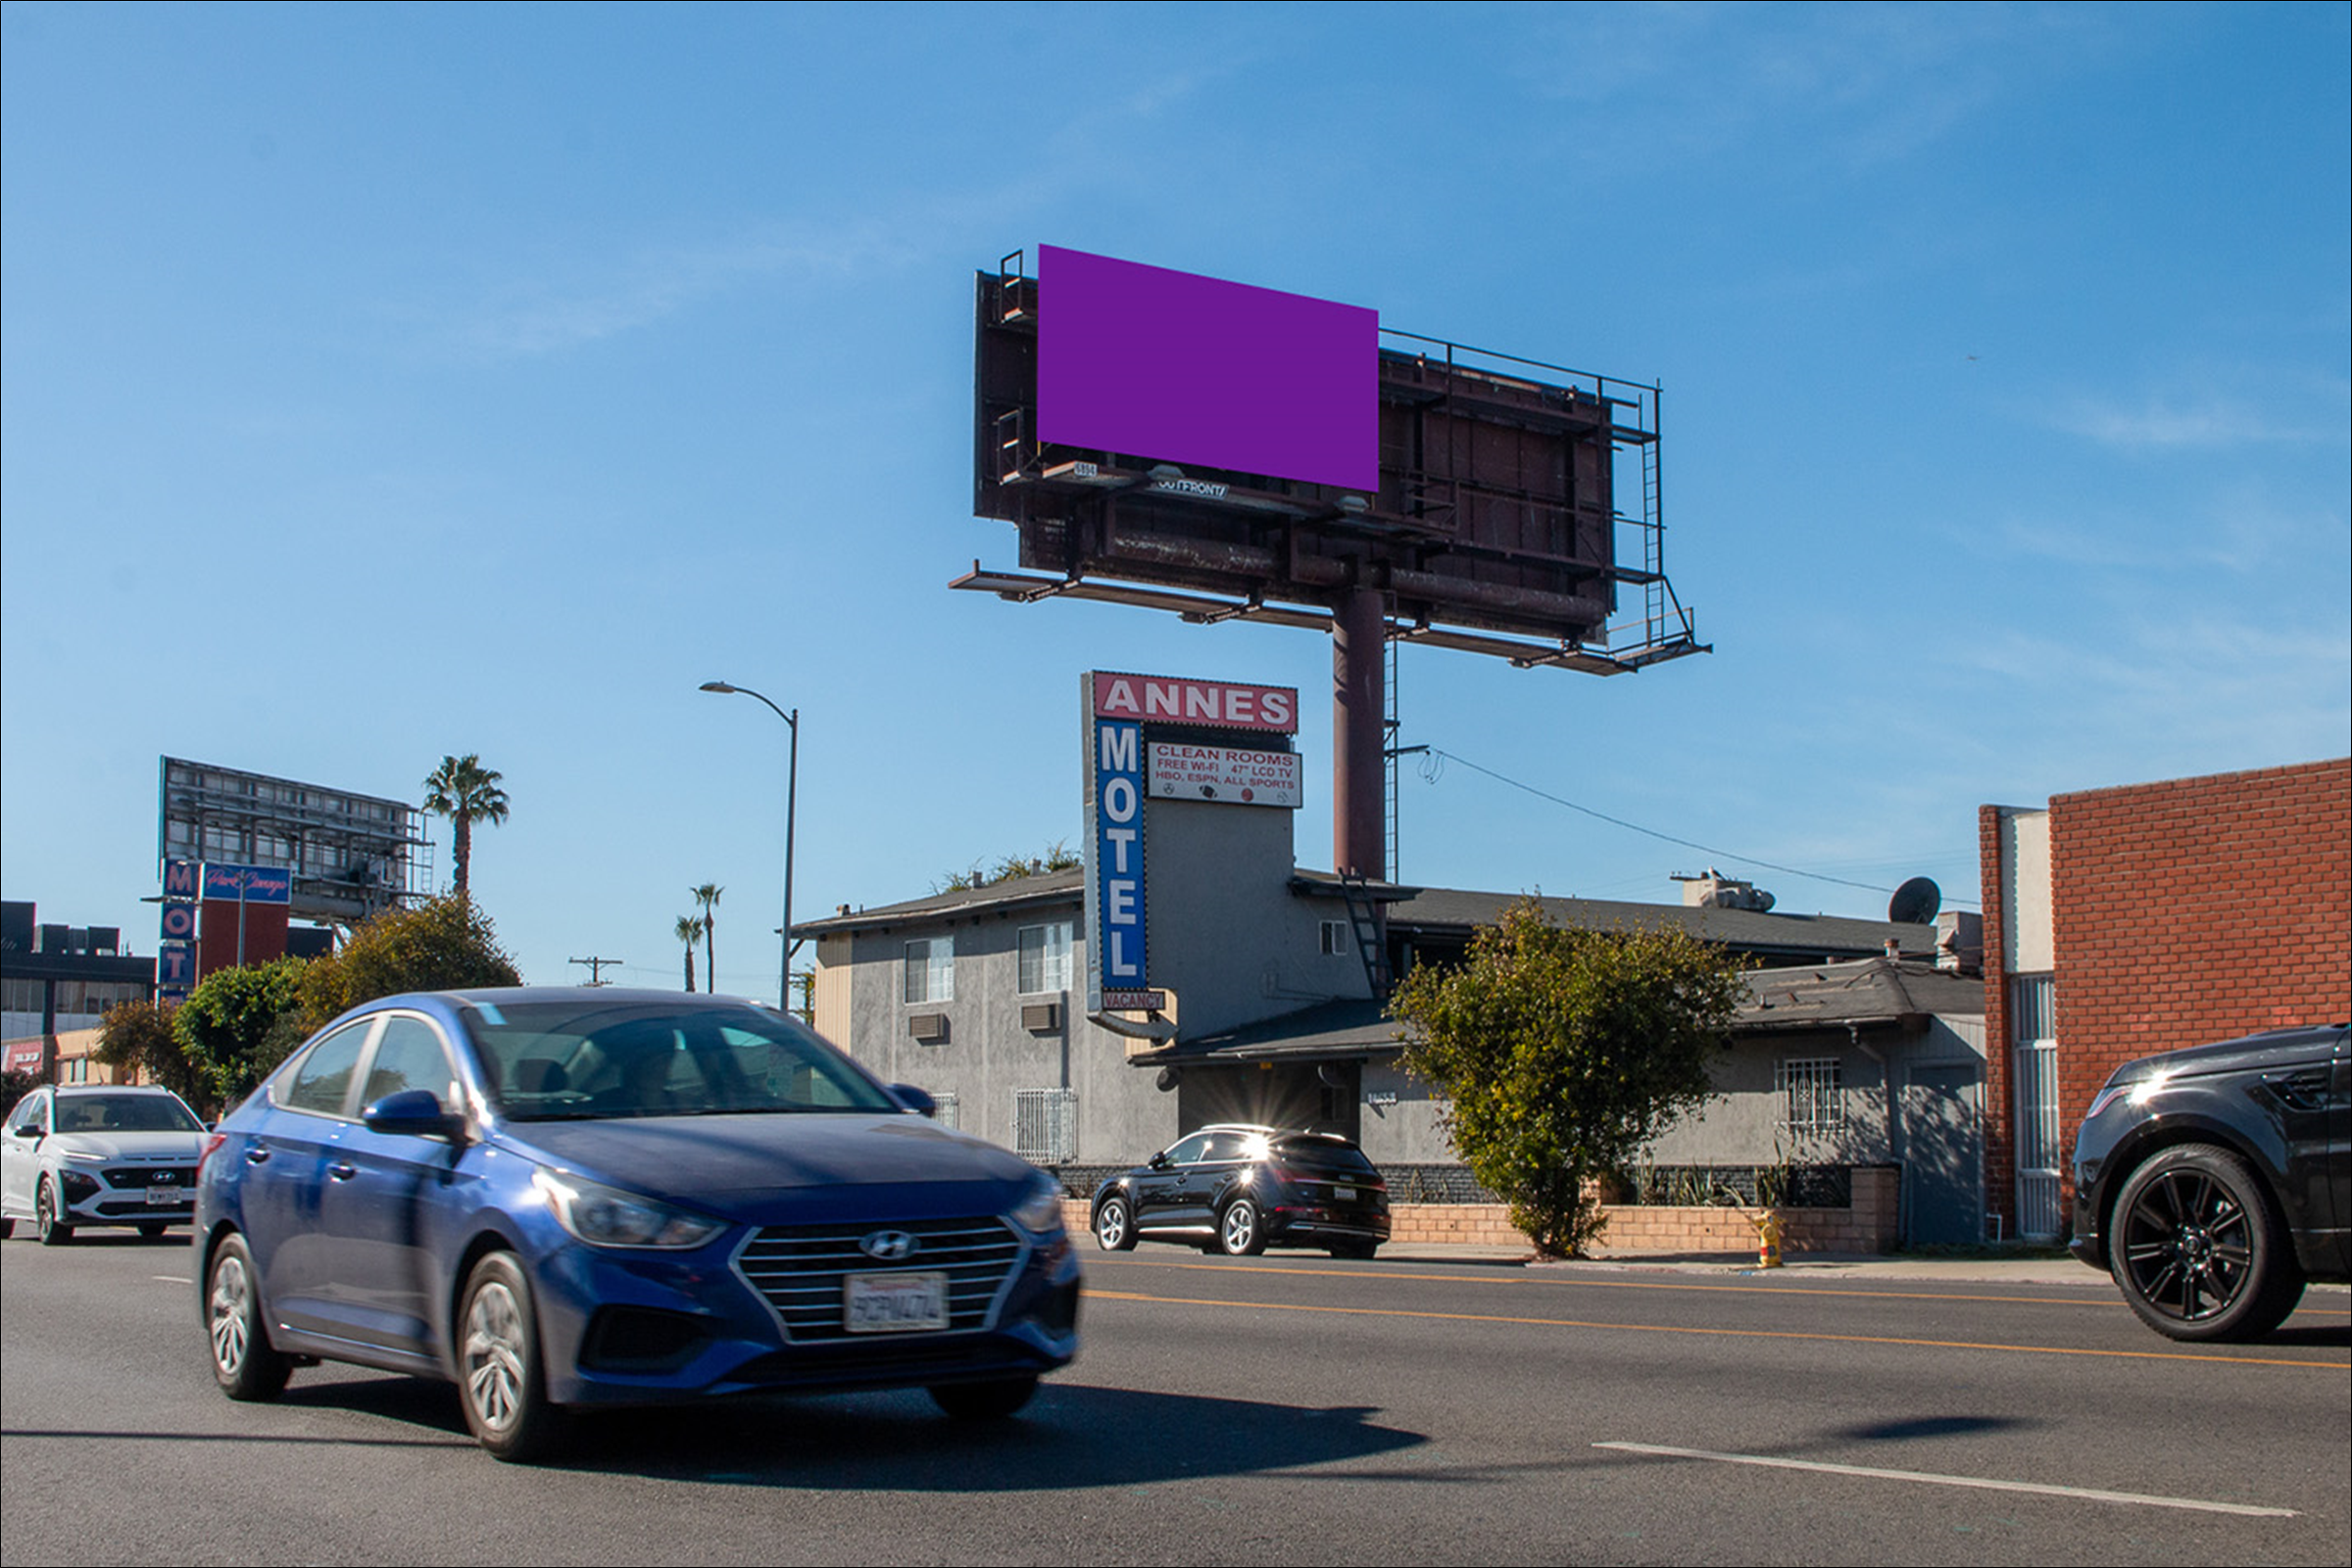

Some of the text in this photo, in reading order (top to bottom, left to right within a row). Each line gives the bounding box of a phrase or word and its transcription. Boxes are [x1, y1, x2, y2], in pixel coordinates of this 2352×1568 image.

[1103, 679, 1290, 725] ANNES
[1156, 745, 1294, 767] CLEAN ROOMS
[1157, 759, 1189, 770] FREE
[1191, 760, 1219, 772] WI-FI
[1251, 765, 1276, 777] LCD
[1278, 768, 1294, 779] TV
[1155, 770, 1295, 790] HBO, ESPN, ALL SPORTS
[1101, 725, 1138, 976] MOTEL
[1103, 992, 1161, 1008] VACANCY
